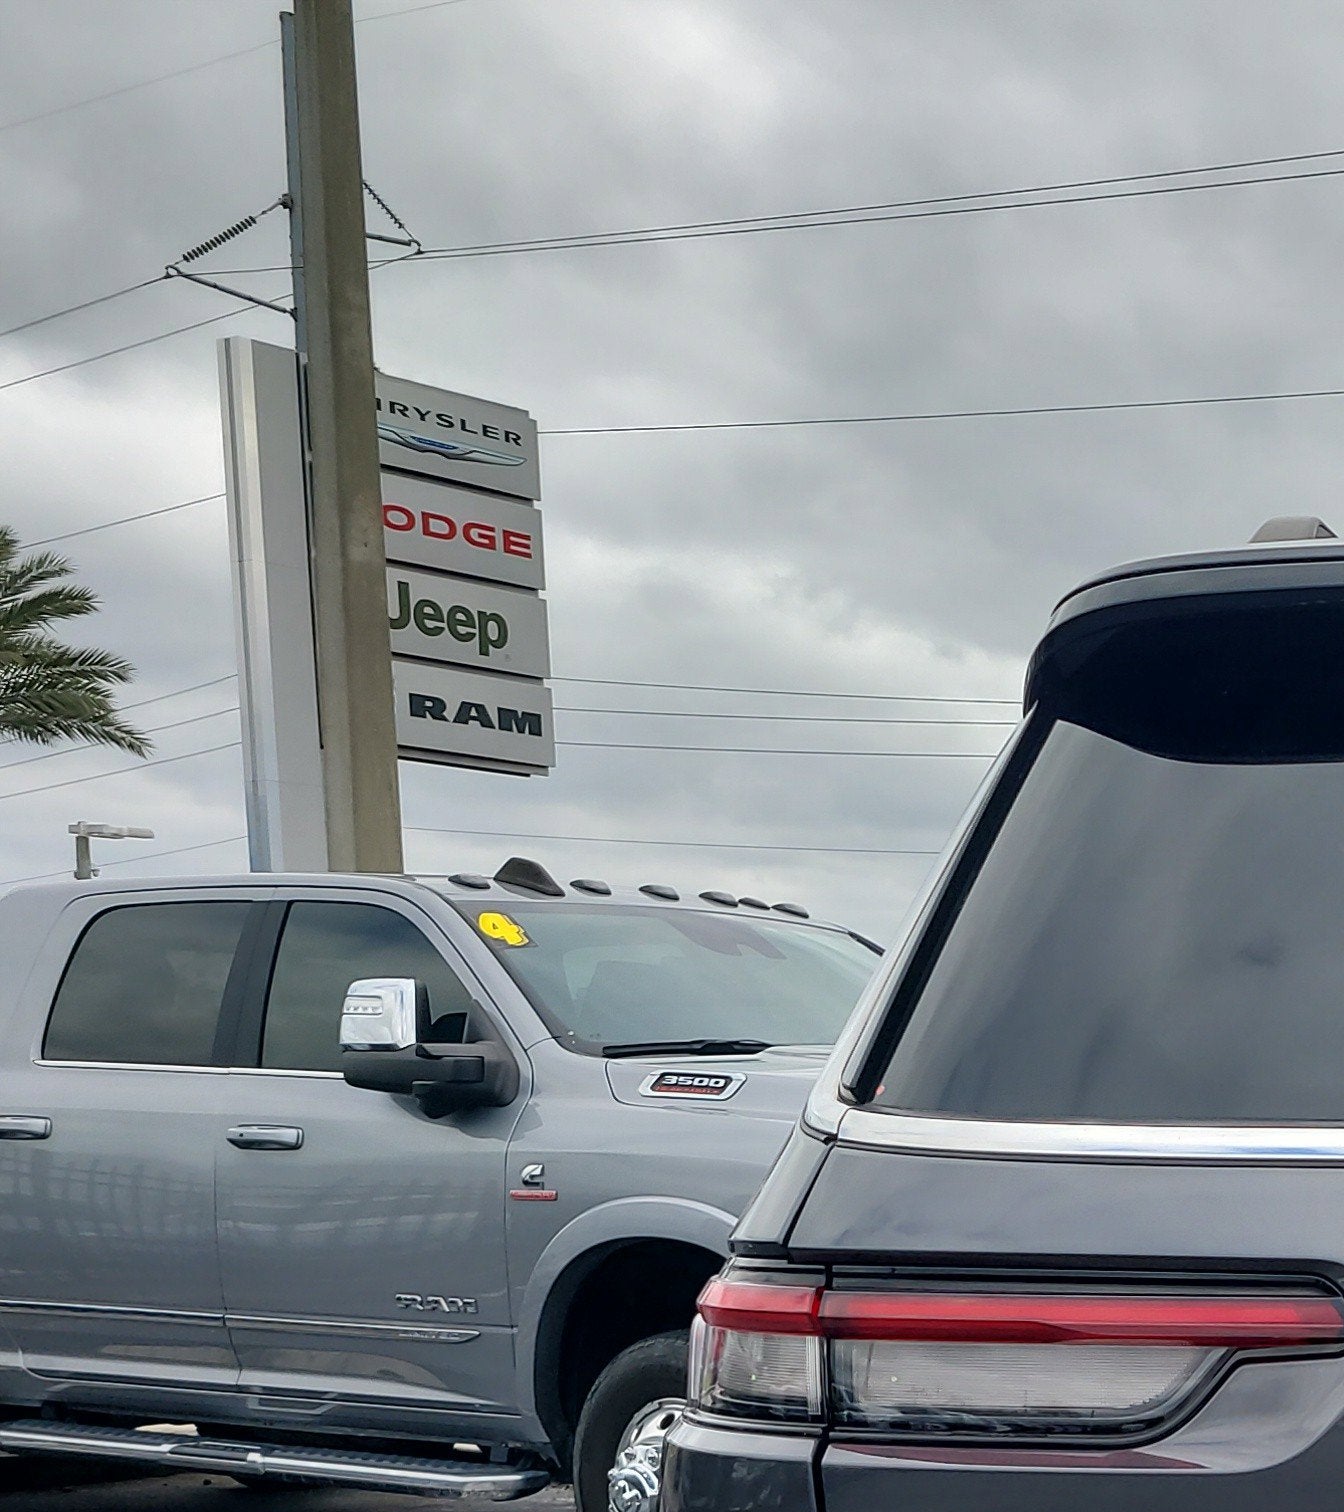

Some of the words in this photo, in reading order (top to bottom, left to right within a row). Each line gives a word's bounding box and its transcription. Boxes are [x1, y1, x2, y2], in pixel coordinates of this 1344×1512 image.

[376, 398, 523, 447] RYSLER
[382, 505, 533, 559] ODGE
[389, 581, 509, 656] Jeep
[408, 692, 543, 737] RAM
[479, 912, 529, 946] 4
[661, 1075, 726, 1088] 3500
